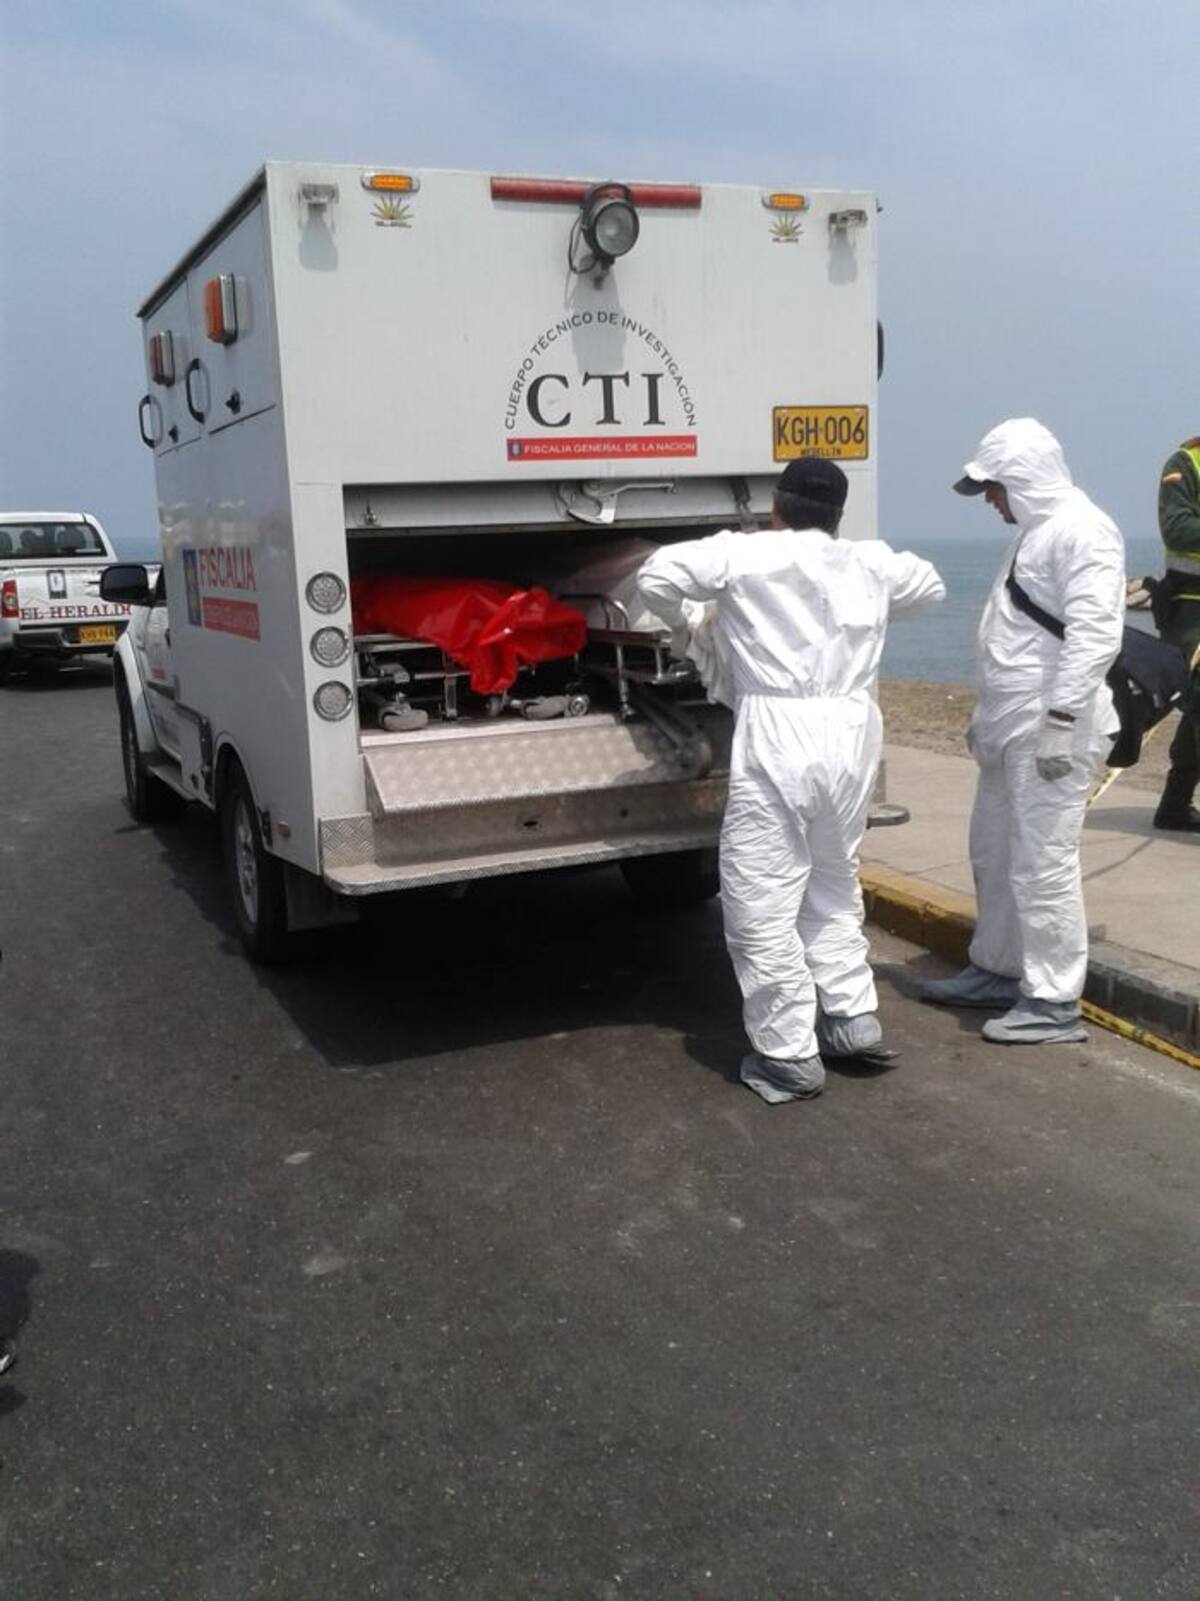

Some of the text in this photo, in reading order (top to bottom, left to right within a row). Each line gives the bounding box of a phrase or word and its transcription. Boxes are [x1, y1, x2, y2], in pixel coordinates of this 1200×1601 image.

[505, 357, 535, 430] CUERPO
[597, 311, 619, 325] DE
[526, 371, 667, 428] CTI
[524, 444, 573, 454] FISCALIA
[574, 443, 622, 453] GENERAL
[624, 442, 639, 452] DE
[641, 442, 656, 452] LA
[198, 546, 257, 592] FISCALIA
[21, 607, 44, 620] EL
